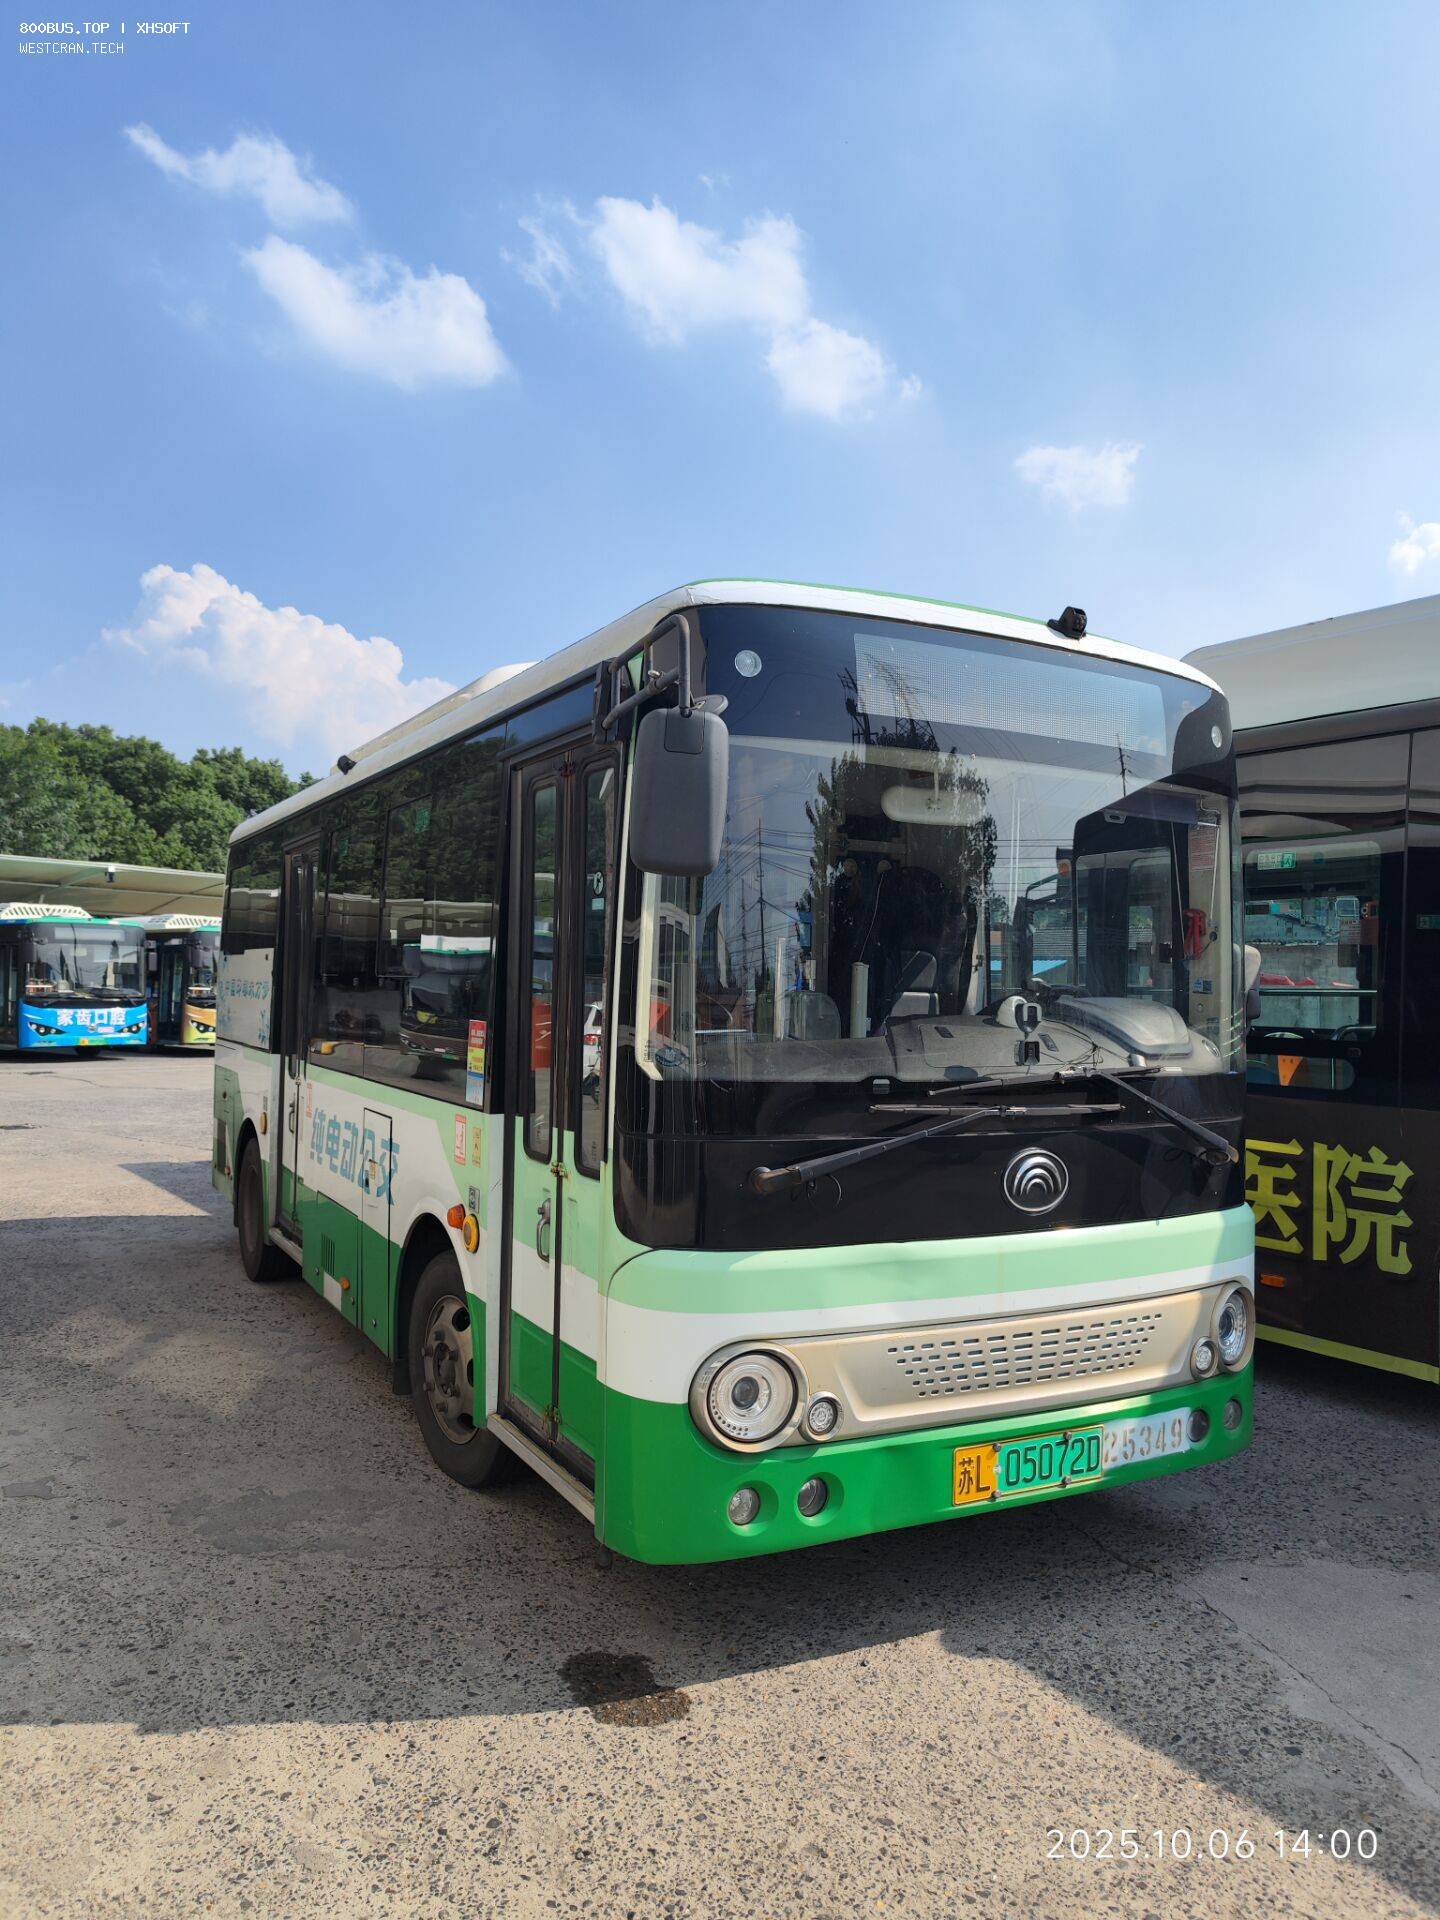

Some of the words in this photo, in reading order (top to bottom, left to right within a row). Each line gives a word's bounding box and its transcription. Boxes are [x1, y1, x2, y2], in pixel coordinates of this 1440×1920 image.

[56, 1008, 126, 1026] 家齿口腔
[310, 1108, 400, 1206] 纯电动公交
[1245, 1138, 1415, 1275] 医院
[1005, 1435, 1101, 1487] 05072D
